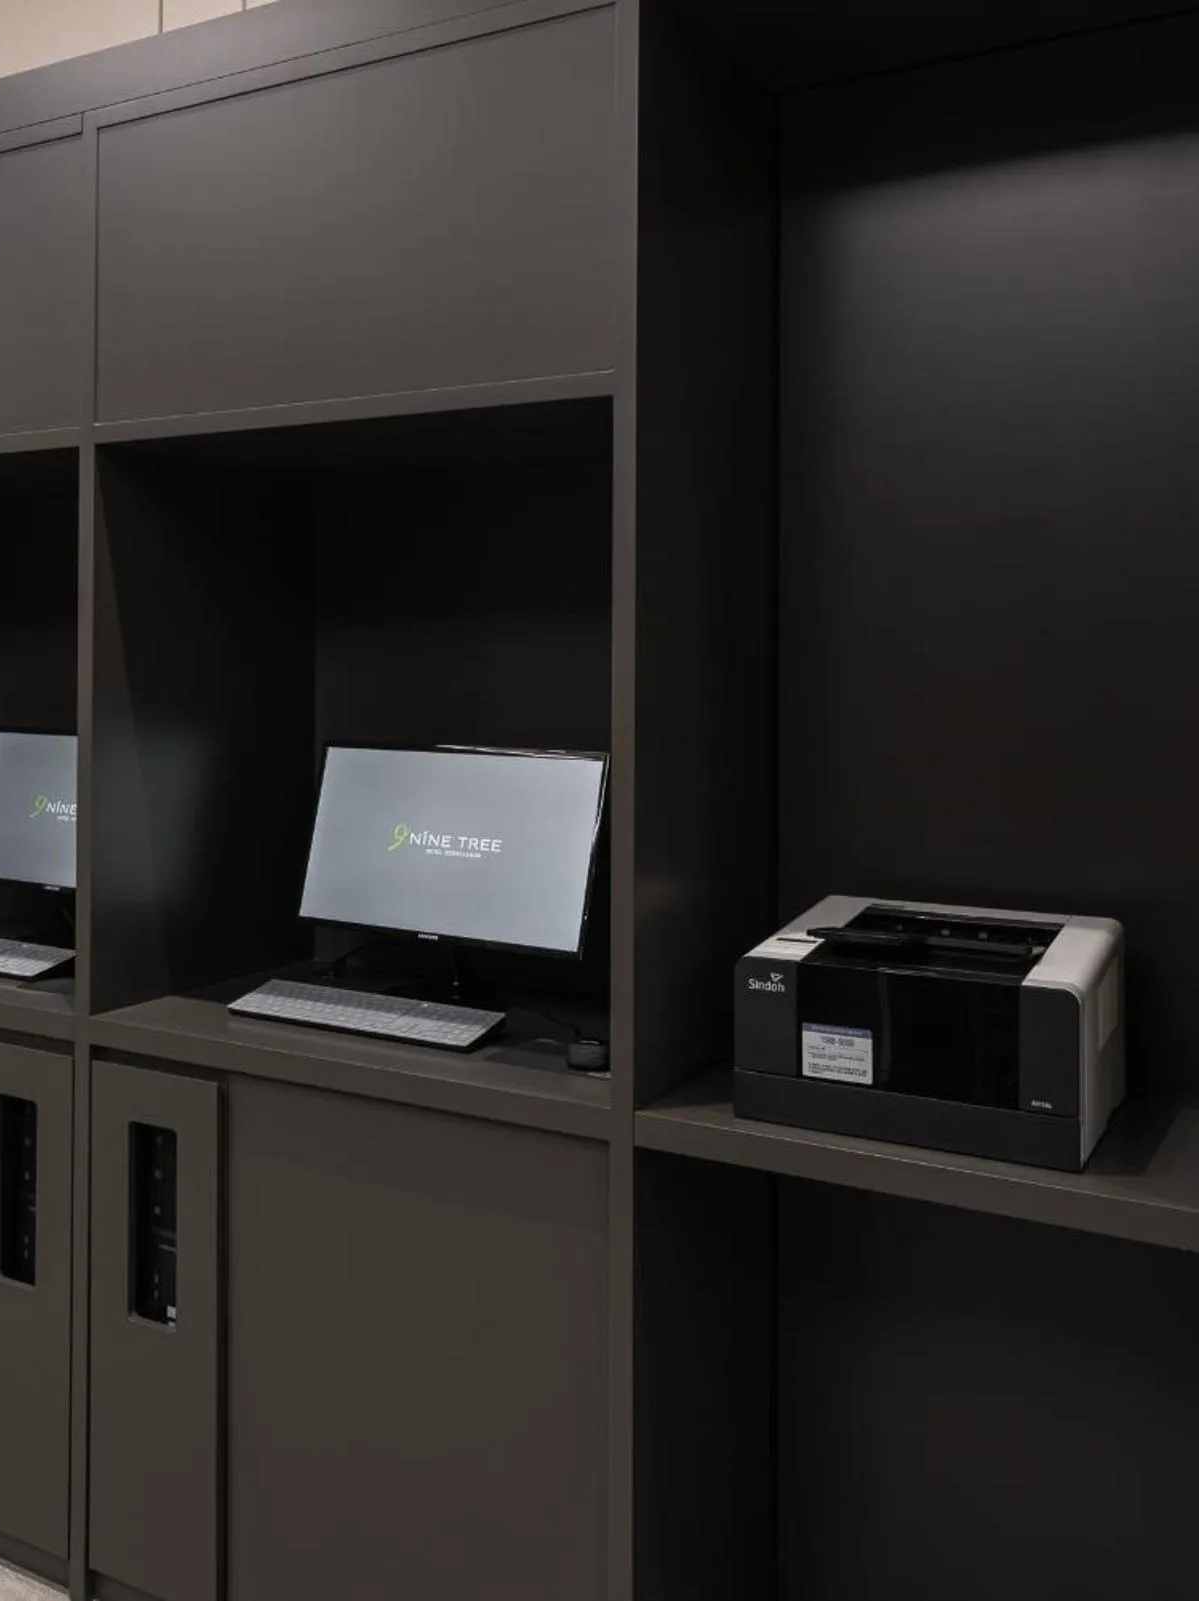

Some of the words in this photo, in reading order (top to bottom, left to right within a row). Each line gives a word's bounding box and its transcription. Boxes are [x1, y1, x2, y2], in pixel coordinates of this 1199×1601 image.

[409, 831, 452, 848] NINE
[458, 836, 502, 852] TREE
[748, 978, 785, 993] Sindoh
